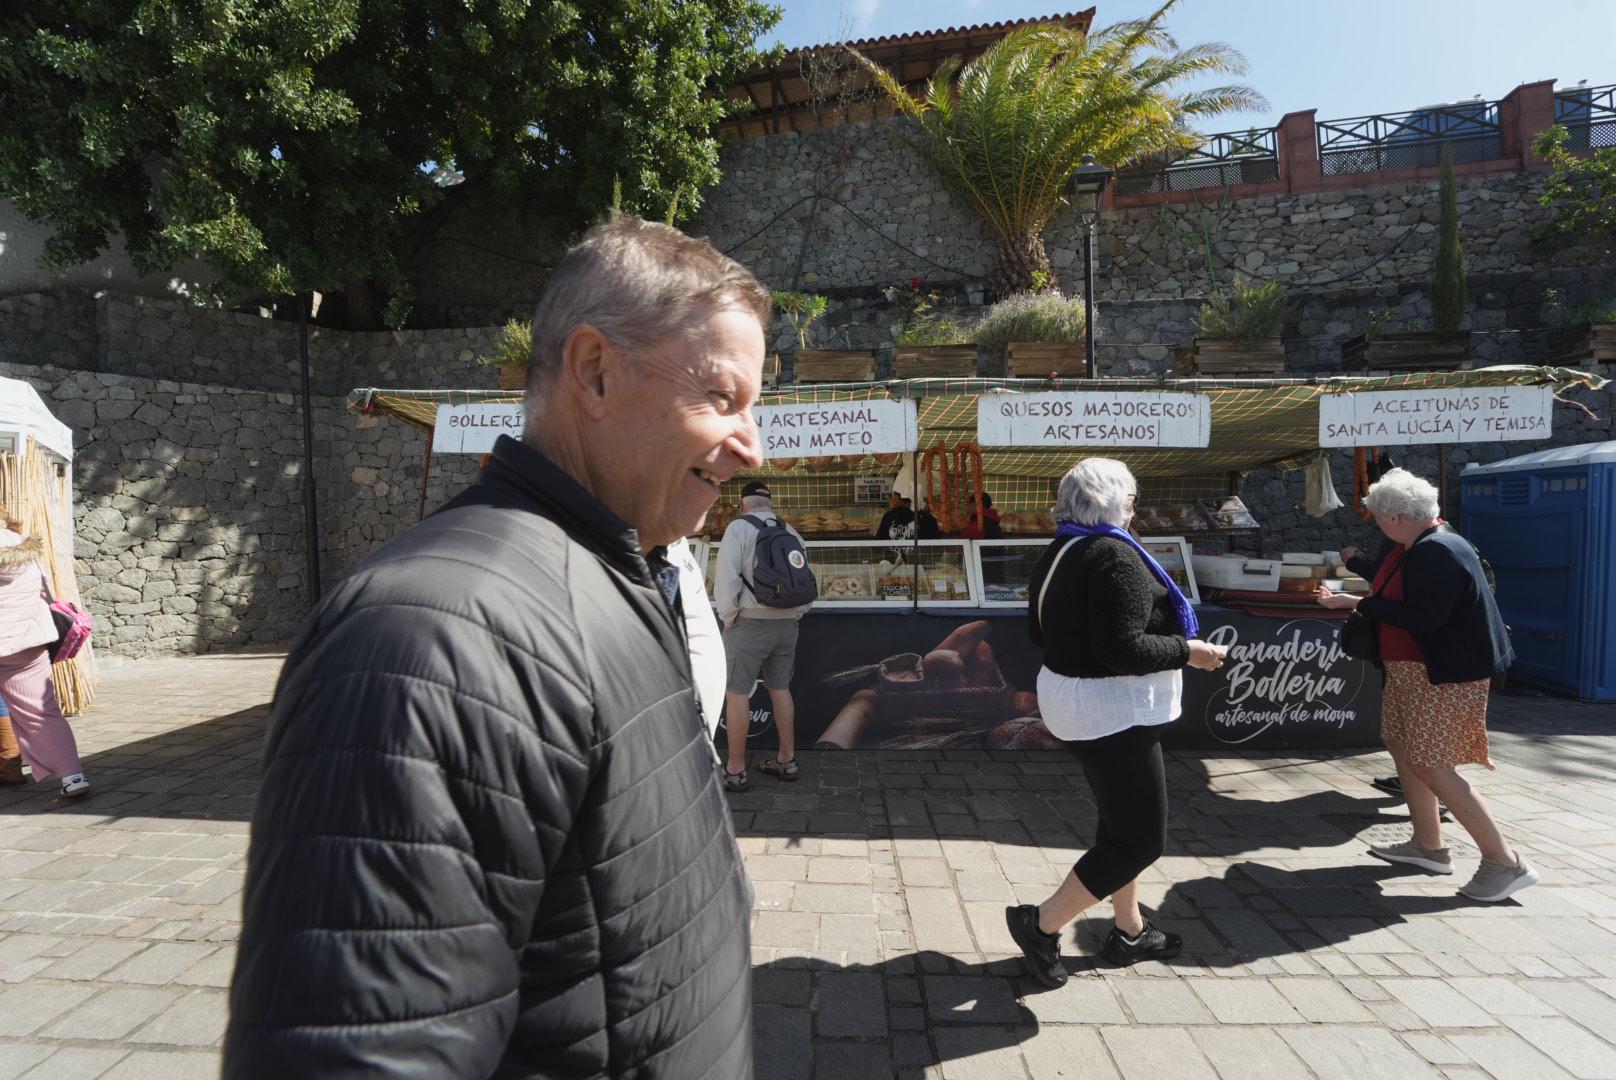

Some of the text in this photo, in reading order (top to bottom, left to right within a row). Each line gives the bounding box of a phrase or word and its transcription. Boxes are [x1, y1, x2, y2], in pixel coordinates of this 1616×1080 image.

[1000, 401, 1196, 418] QUESOS MAJOREROS
[1372, 395, 1511, 414] ACEITUNAS DE
[449, 411, 523, 428] BOLLERÍ
[770, 408, 879, 428] ARTESANAL
[1326, 411, 1547, 438] SANTA LUCÍA Y TEMISA
[767, 430, 873, 450] SAN MATEO
[1043, 424, 1156, 441] ARTESANOS
[1215, 702, 1357, 729] artesanal de moya
